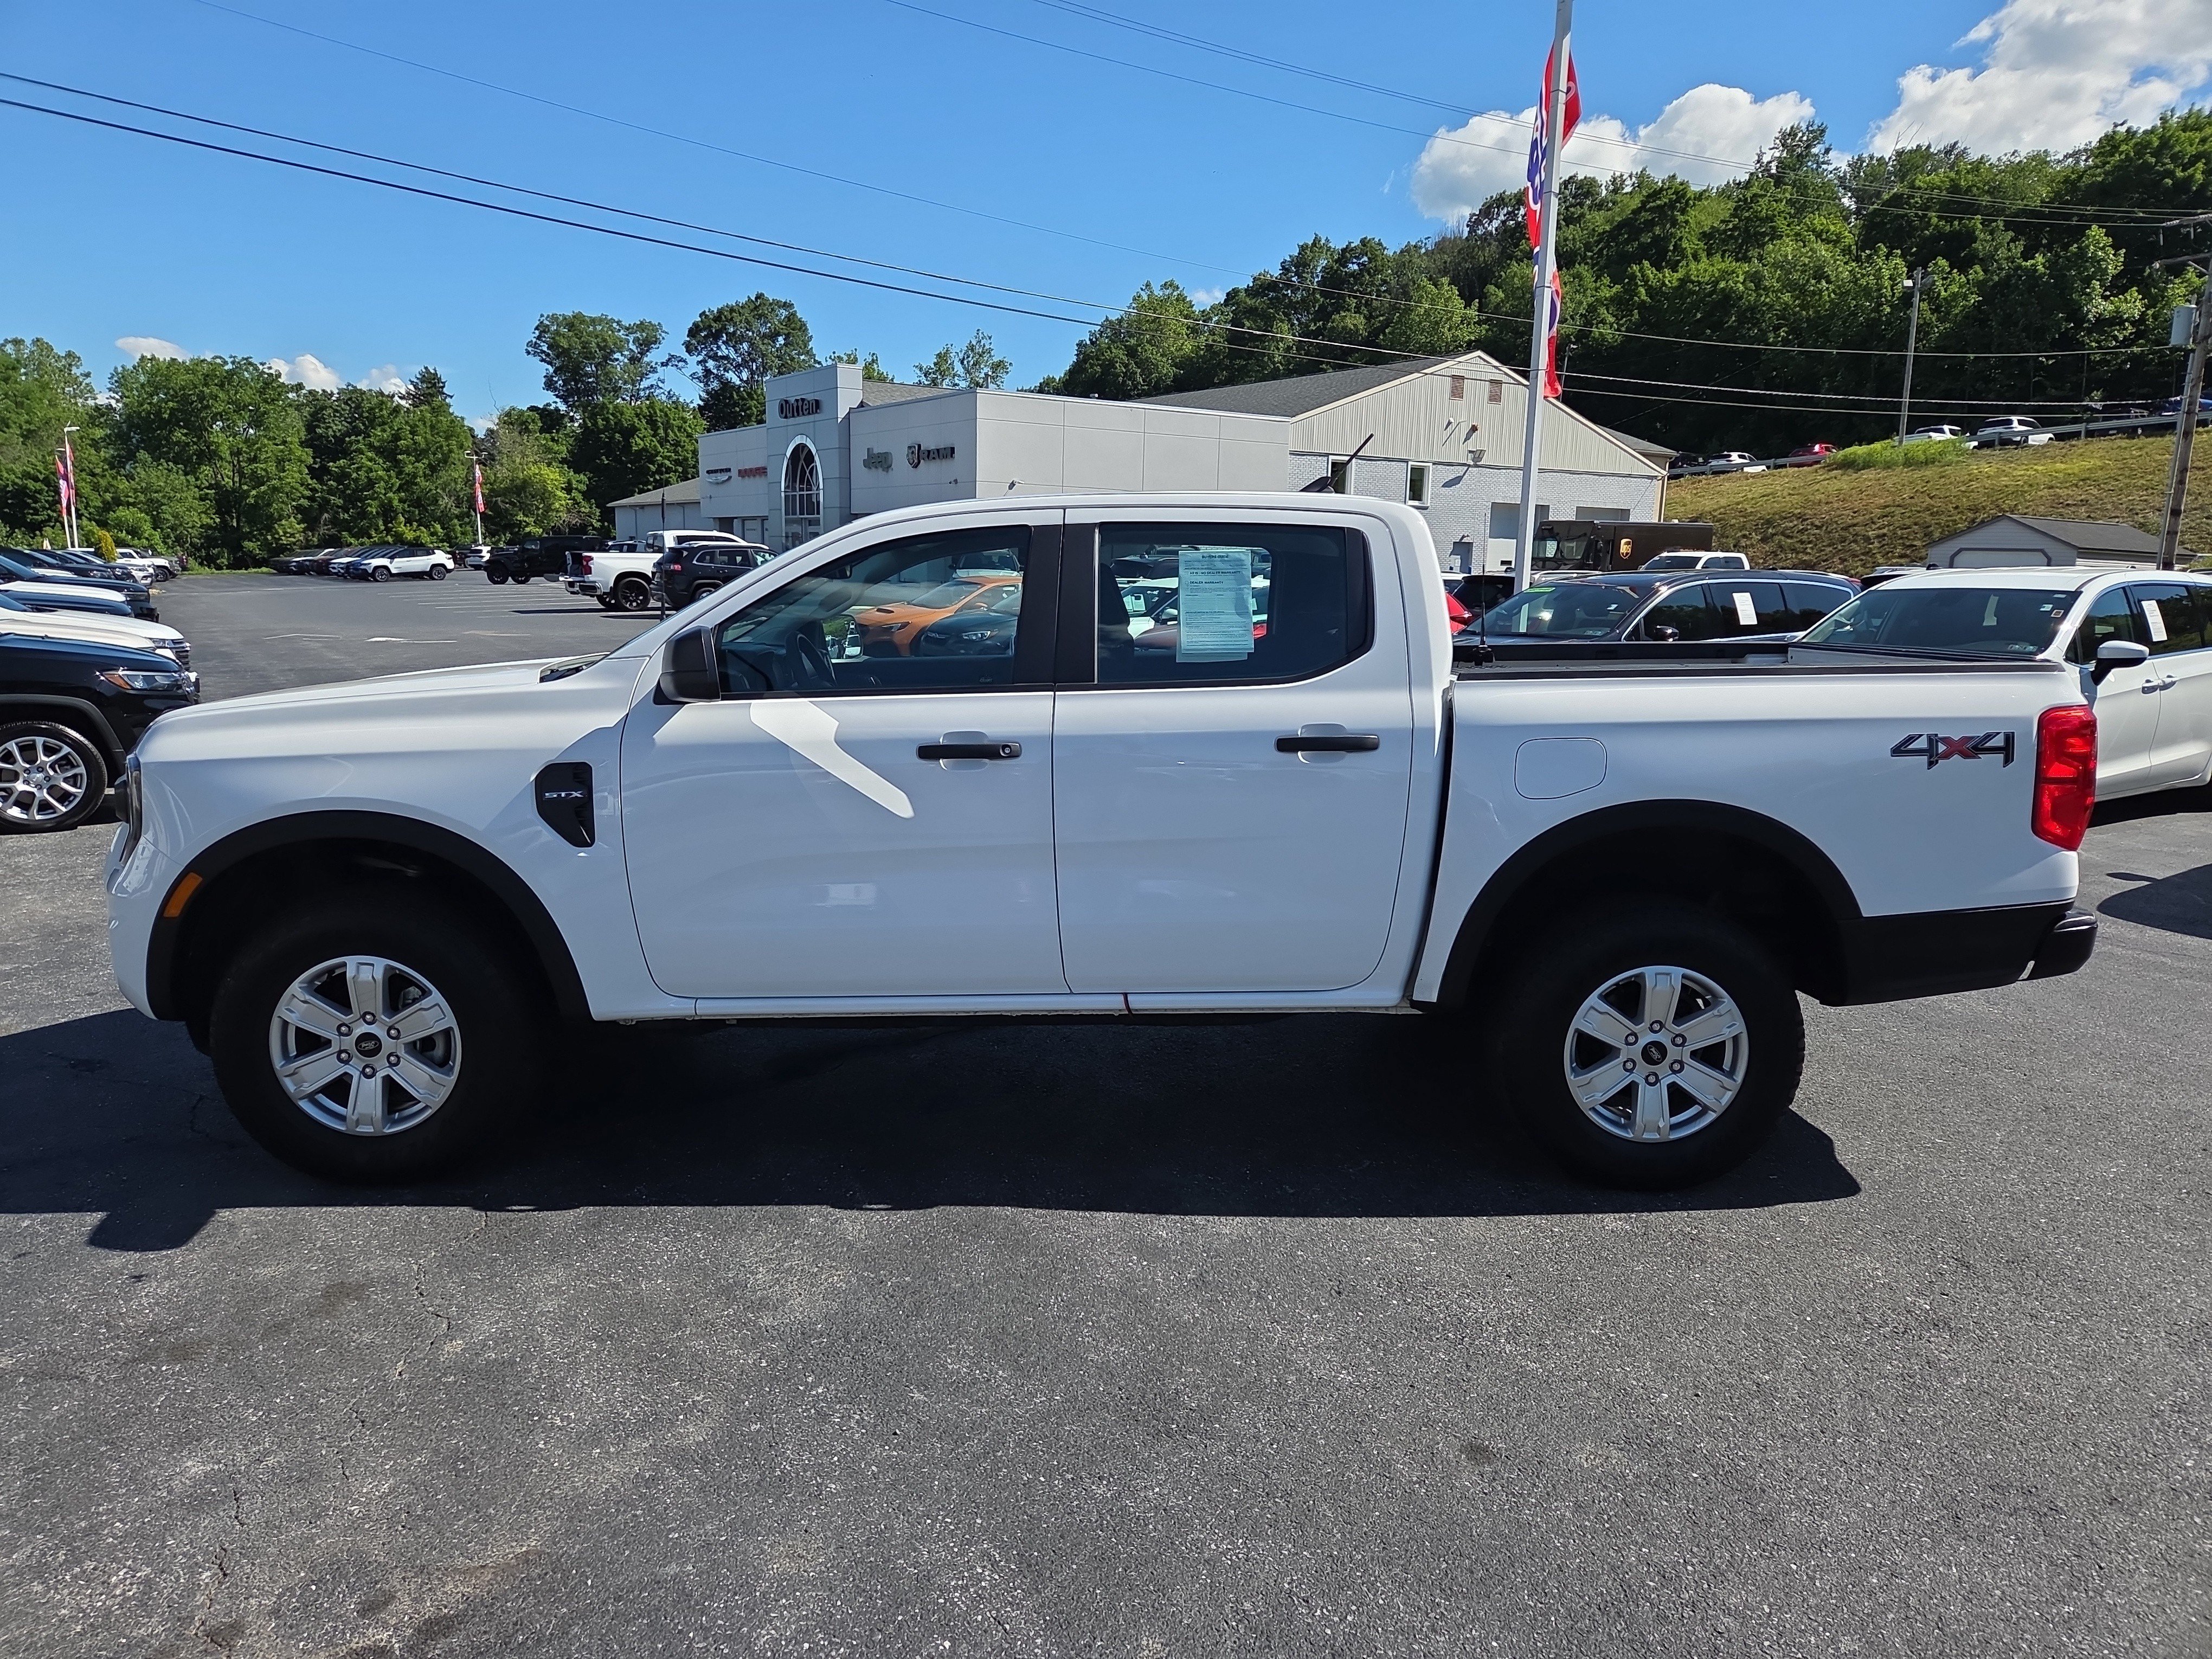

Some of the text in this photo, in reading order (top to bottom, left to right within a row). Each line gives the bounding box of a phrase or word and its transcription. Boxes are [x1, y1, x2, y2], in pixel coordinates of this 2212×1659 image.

[863, 448, 893, 473] Jeep
[920, 447, 955, 461] RAM
[545, 790, 584, 799] STX
